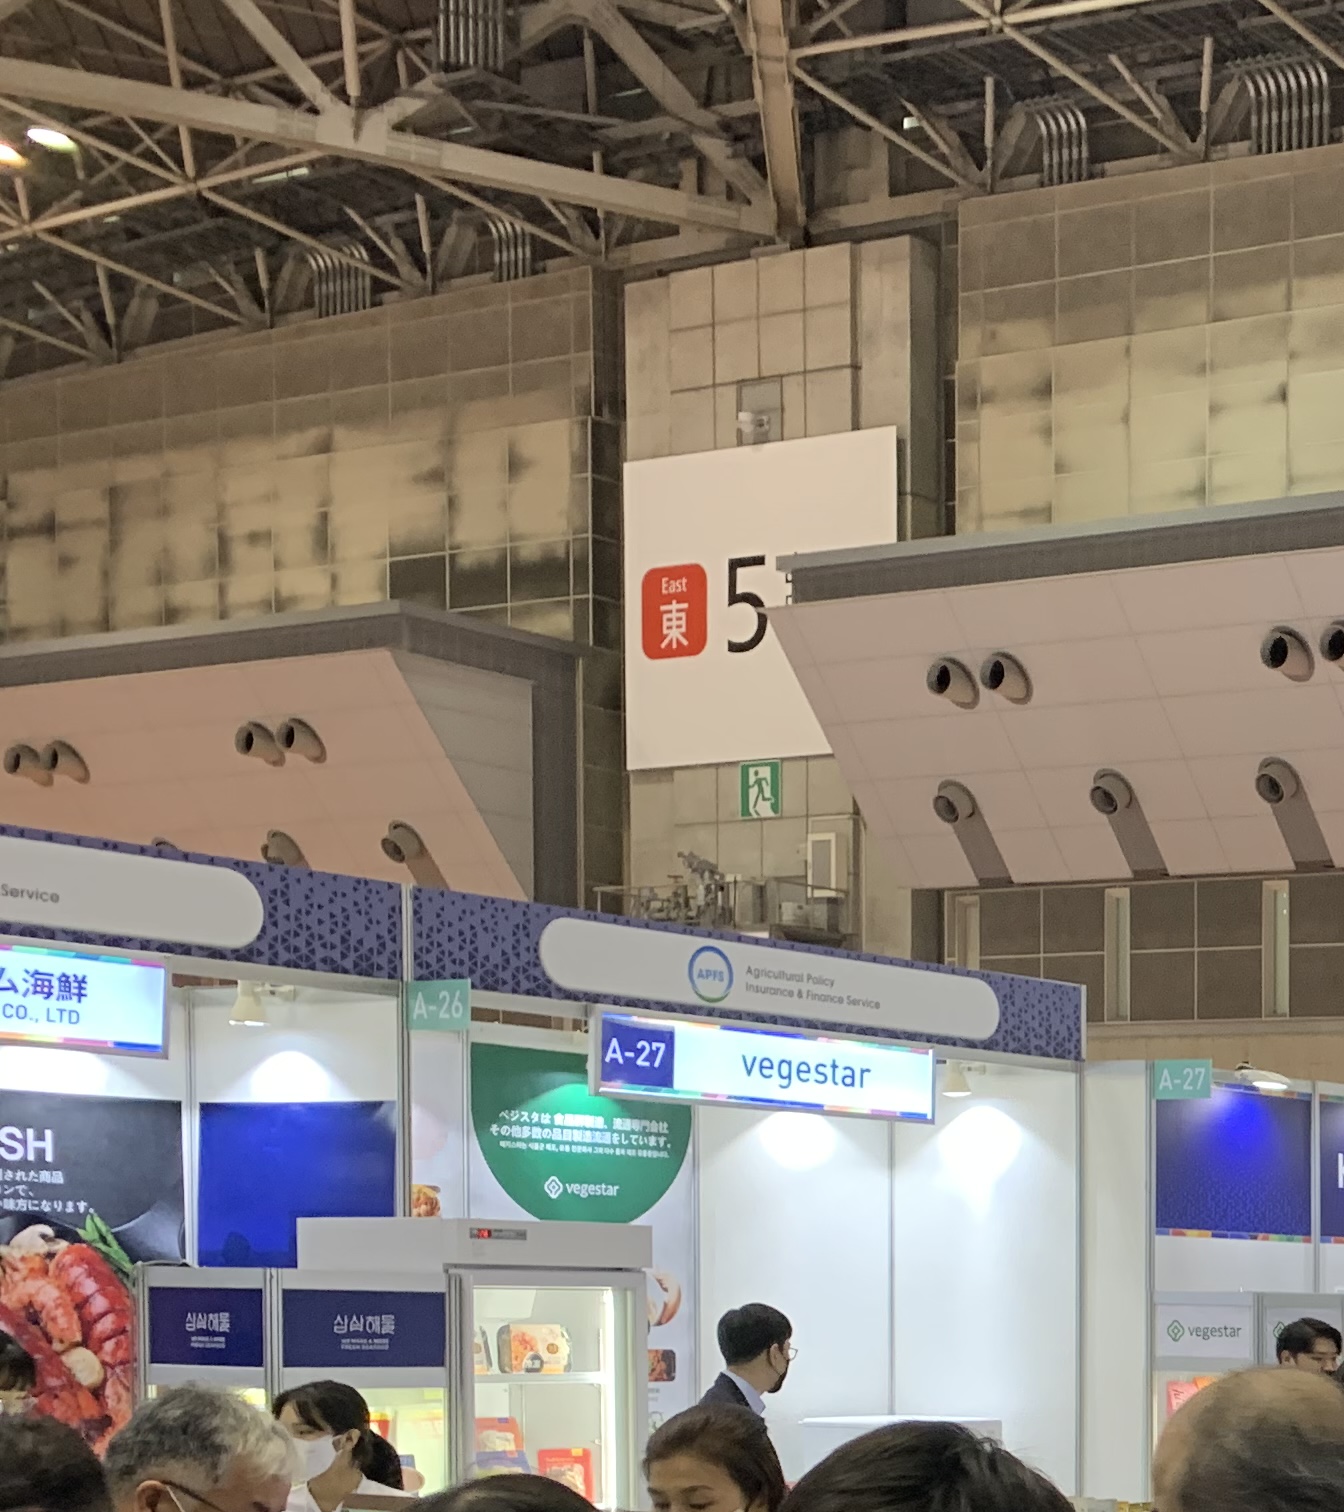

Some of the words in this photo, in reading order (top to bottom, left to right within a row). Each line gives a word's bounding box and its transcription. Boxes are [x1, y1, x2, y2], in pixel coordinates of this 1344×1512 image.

[661, 577, 687, 595] East
[728, 555, 769, 653] 5
[659, 600, 689, 649] 東
[0, 883, 60, 903] Service
[697, 968, 724, 983] APFS
[746, 966, 804, 984] Agricultural
[807, 973, 835, 988] Policy
[413, 990, 463, 1020] A-26
[746, 982, 794, 998] Insurance
[806, 990, 844, 1005] Finance
[847, 995, 881, 1010] Service
[46, 1007, 80, 1025] LTD
[605, 1037, 666, 1068] A-27
[741, 1054, 872, 1089] vegestar
[1159, 1068, 1206, 1091] A-27
[0, 1126, 53, 1162] SH
[0, 1184, 34, 1197] ンで、
[566, 1182, 620, 1198] vegestar
[1188, 1325, 1242, 1340] vegestar
